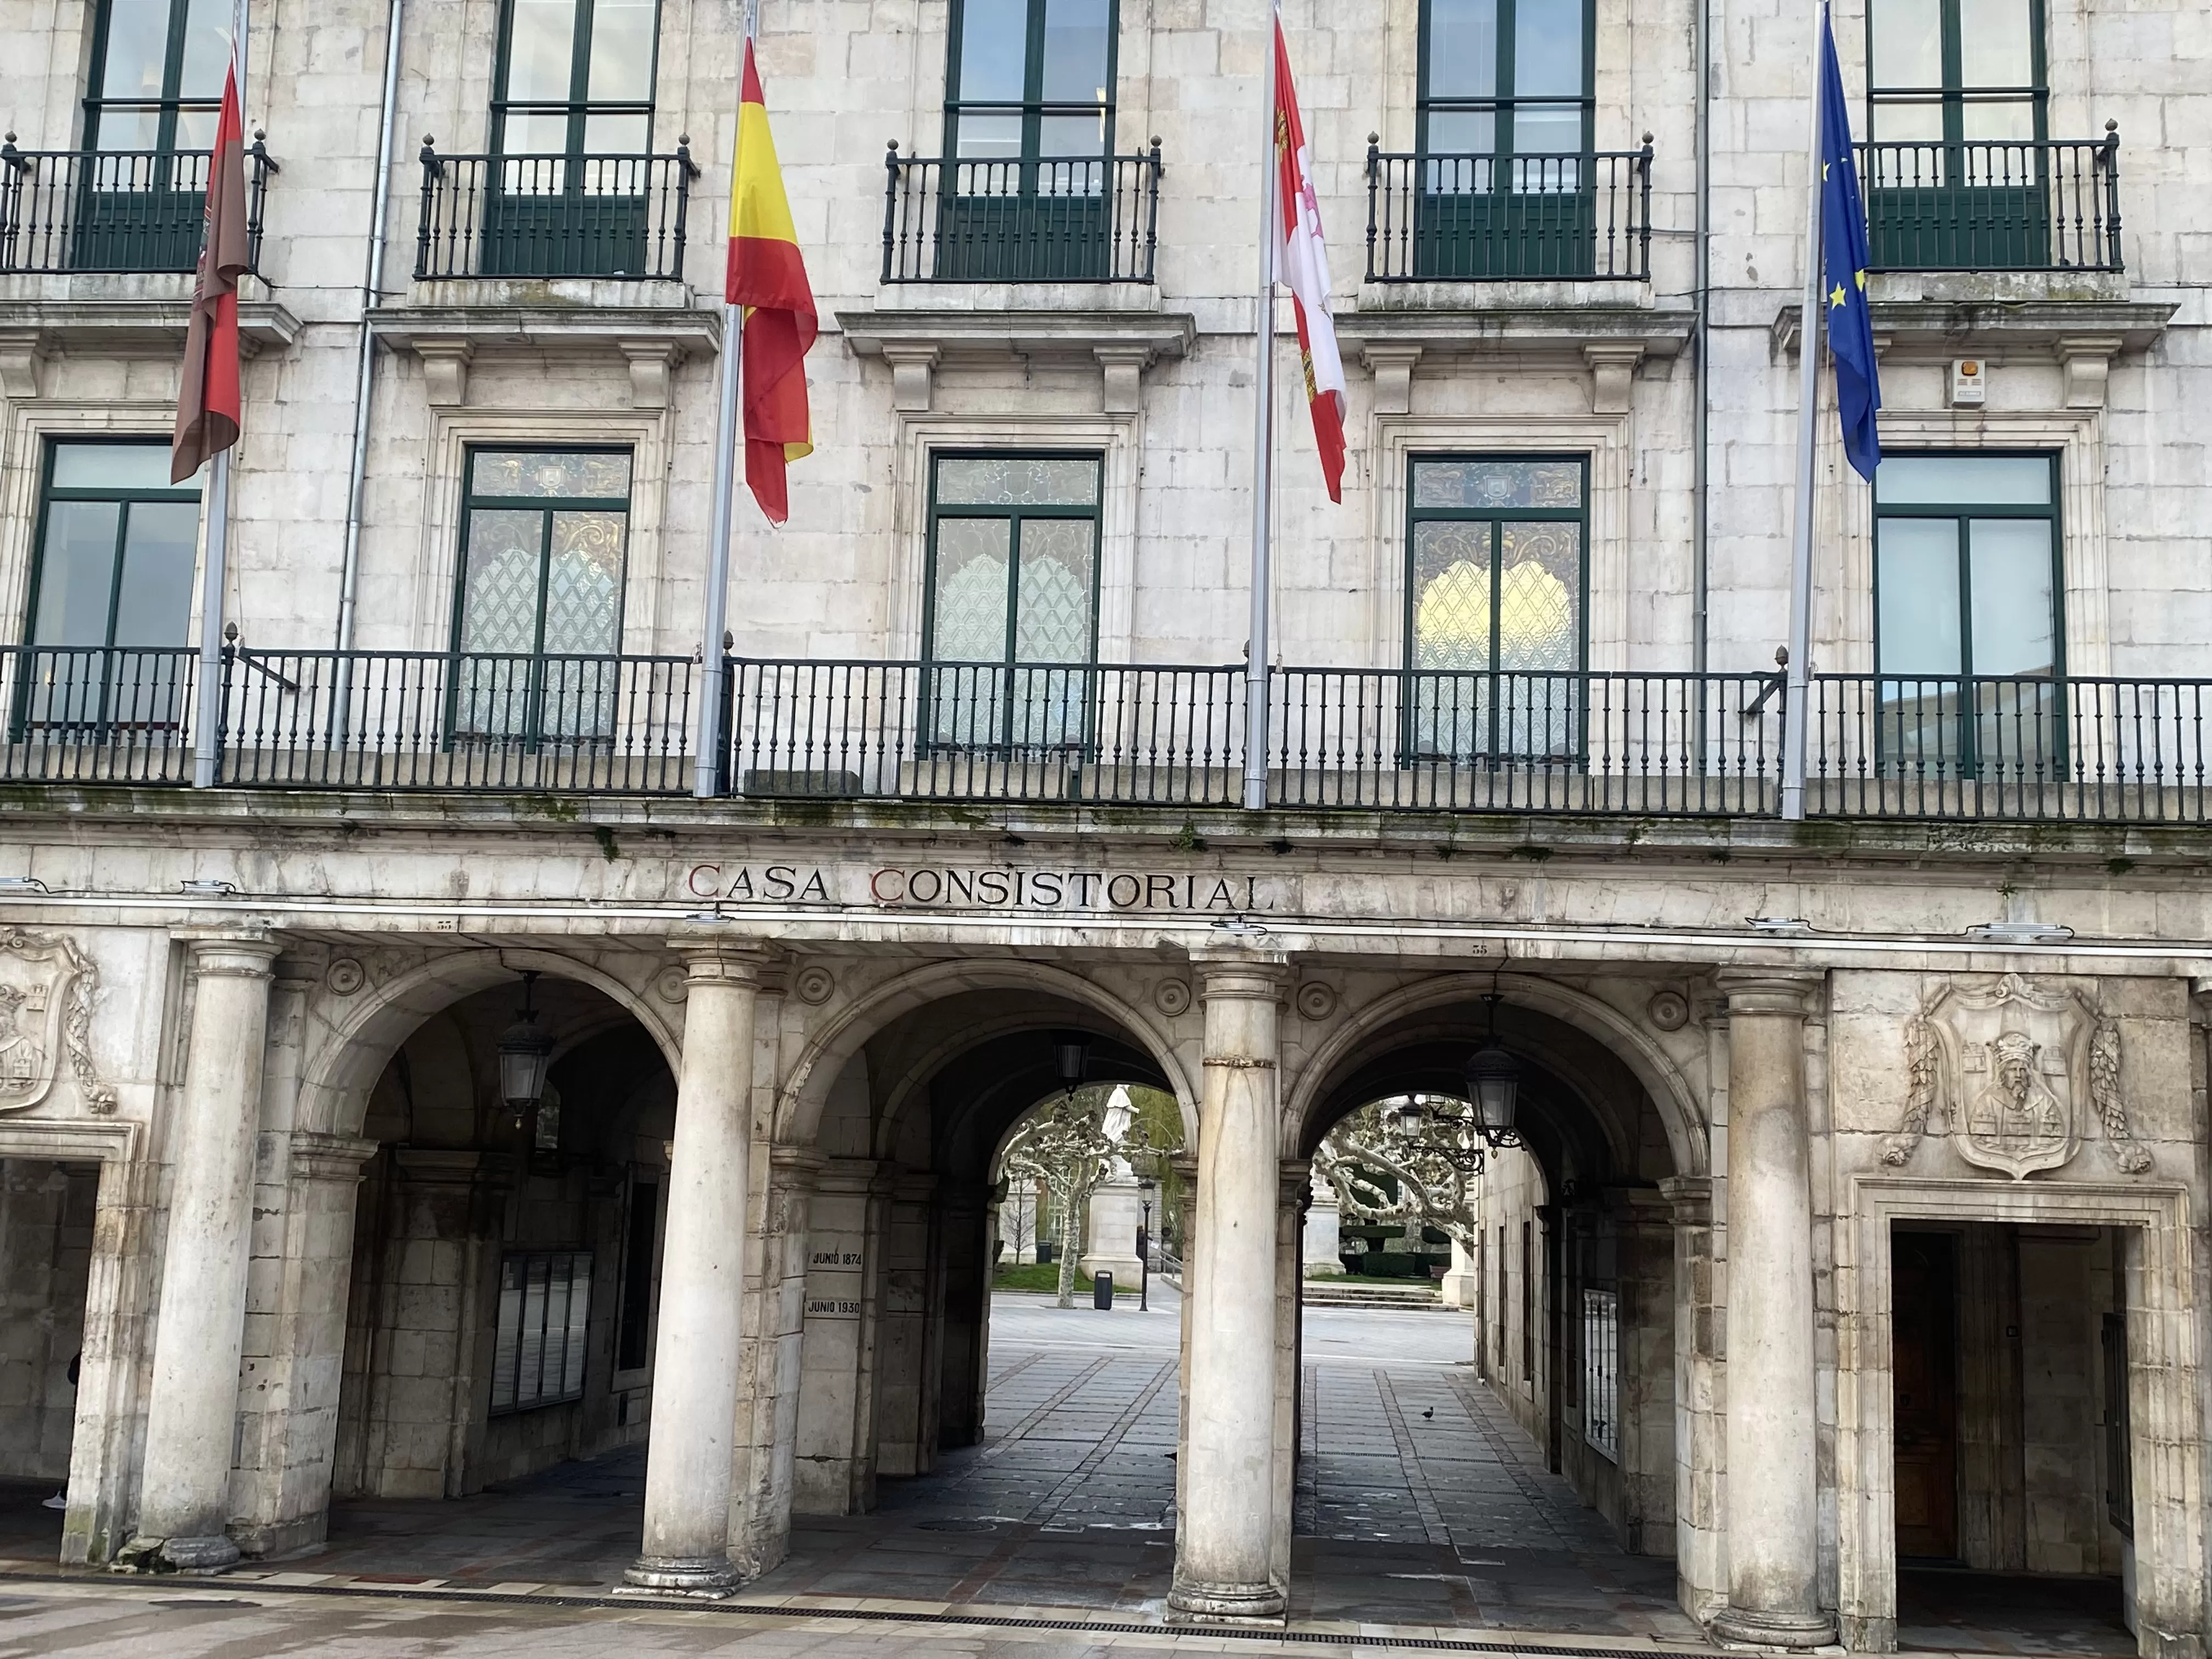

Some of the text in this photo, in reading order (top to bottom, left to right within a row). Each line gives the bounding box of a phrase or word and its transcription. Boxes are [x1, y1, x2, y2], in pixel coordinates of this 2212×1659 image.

[689, 865, 1274, 911] CASA CONSISTORIAL
[1472, 945, 1487, 954] 35
[812, 1253, 861, 1265] JUNIO 1874
[808, 1301, 860, 1313] JUNIO 1930
